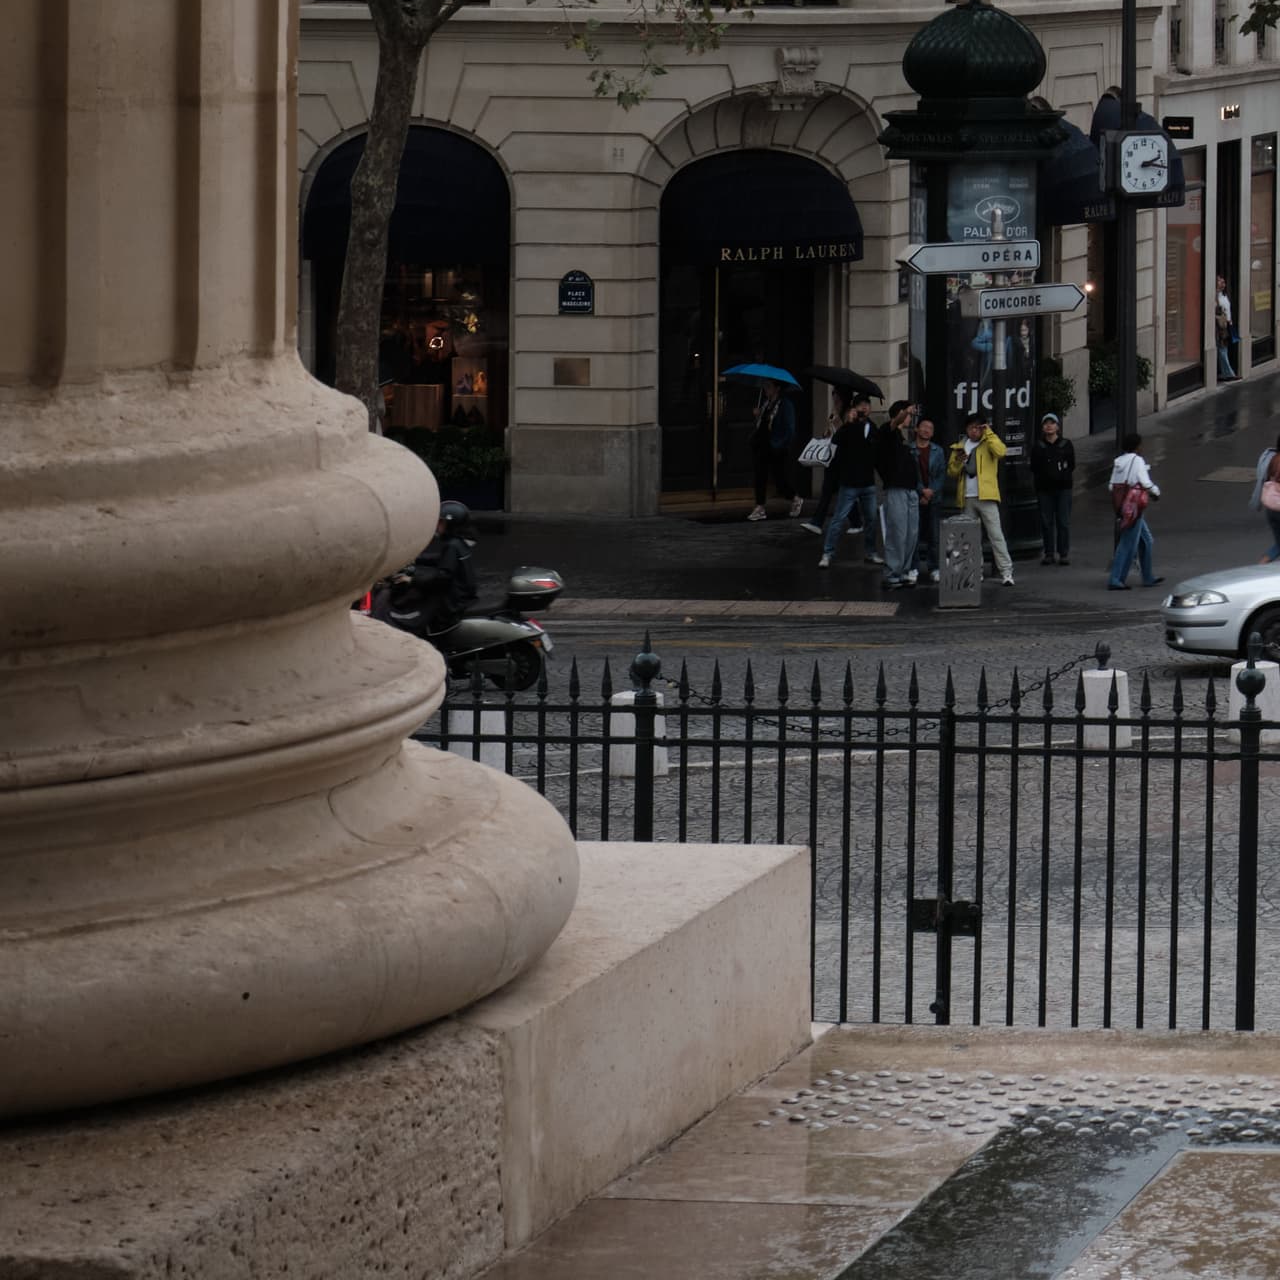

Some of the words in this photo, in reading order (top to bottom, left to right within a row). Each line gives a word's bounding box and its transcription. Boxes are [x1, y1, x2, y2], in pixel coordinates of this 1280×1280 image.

[963, 226, 993, 238] PALM
[1006, 226, 1028, 238] D'OR
[720, 247, 784, 261] RALPH
[795, 242, 856, 259] LAUREN
[982, 248, 1032, 263] OPÉRA
[984, 295, 1041, 310] CONCORDE
